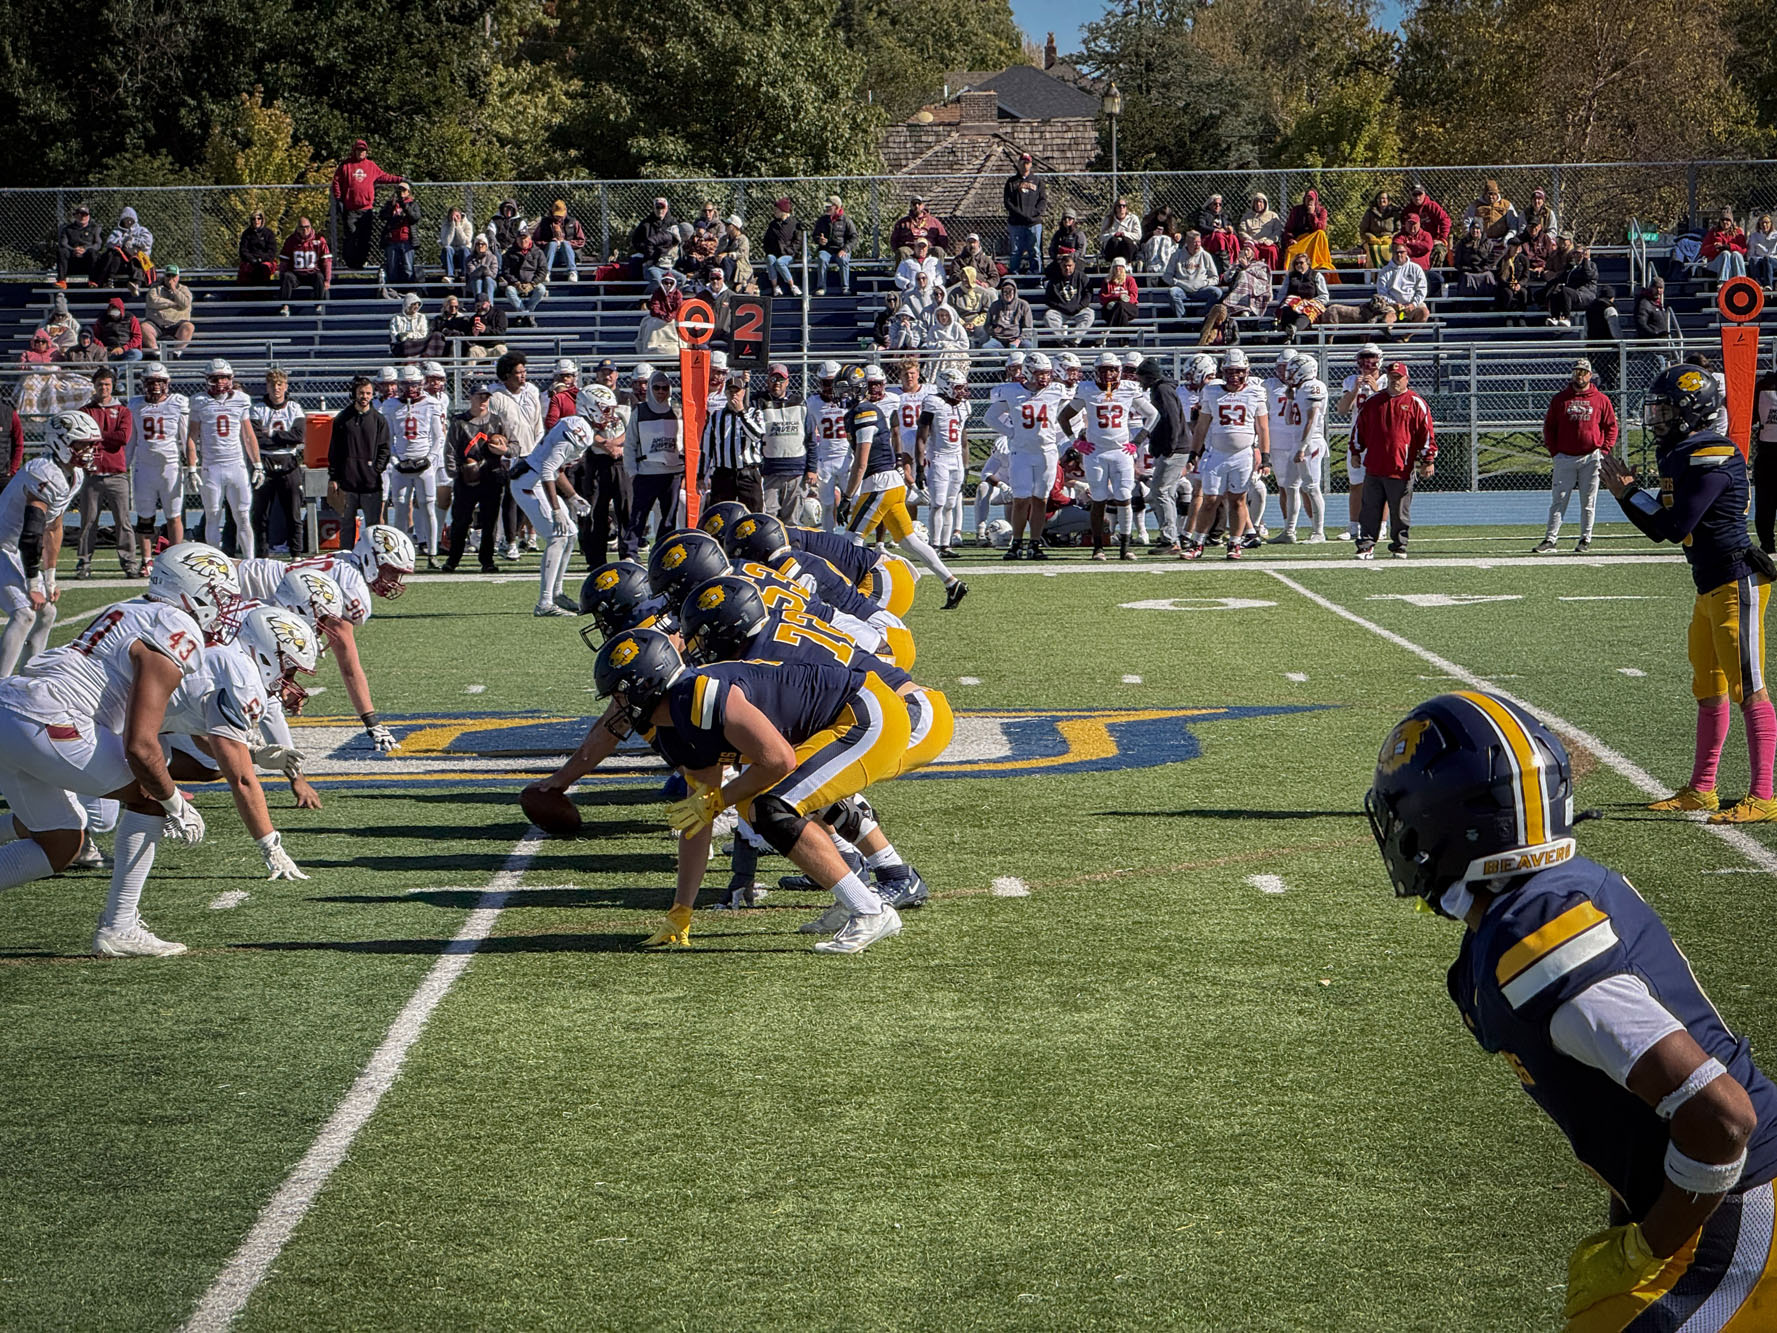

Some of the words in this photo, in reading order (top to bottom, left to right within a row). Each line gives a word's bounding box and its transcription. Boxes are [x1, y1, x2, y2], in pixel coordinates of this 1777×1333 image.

[293, 251, 317, 269] 60
[734, 303, 764, 342] 2
[216, 414, 230, 438] 0
[1022, 404, 1048, 429] 94
[1097, 404, 1123, 428] 52
[1219, 404, 1246, 426] 53
[143, 415, 166, 440] 91
[949, 419, 959, 443] 6
[321, 523, 337, 540] G
[346, 598, 366, 622] 90
[168, 630, 197, 662] 43
[1483, 844, 1572, 876] BEAVERS
